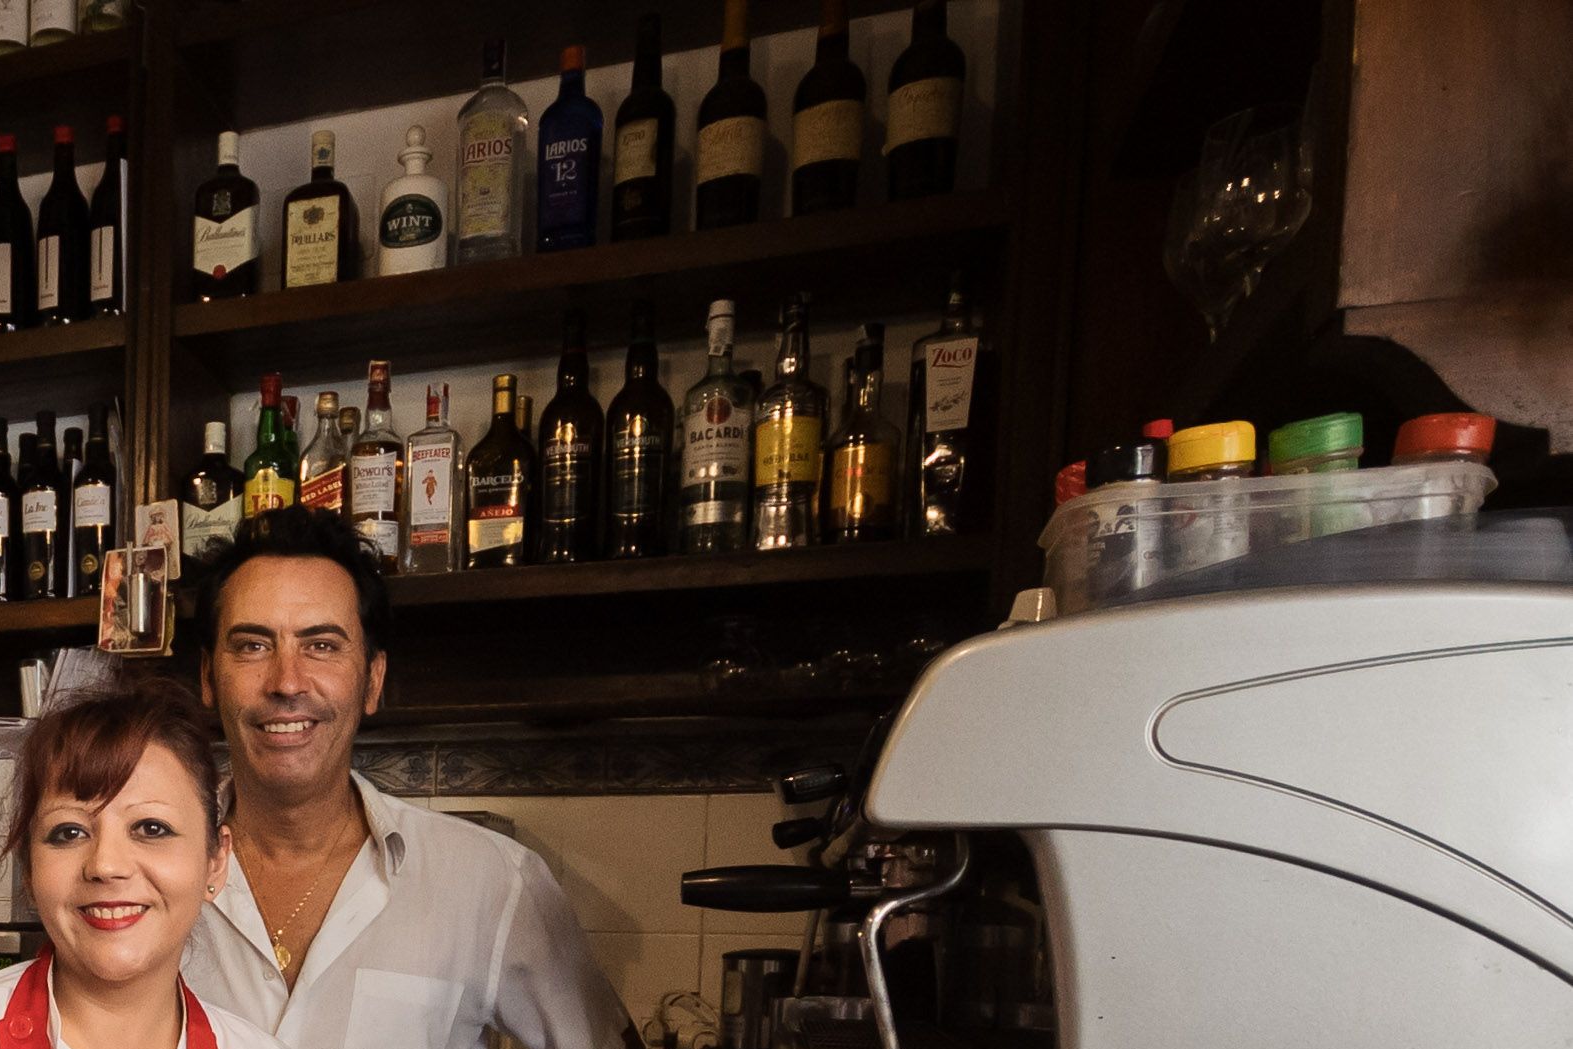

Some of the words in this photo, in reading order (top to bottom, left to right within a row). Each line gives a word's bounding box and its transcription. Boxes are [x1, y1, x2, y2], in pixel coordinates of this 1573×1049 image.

[462, 137, 513, 165] LARIOS
[545, 138, 589, 160] LARIOS
[551, 160, 578, 182] 12
[387, 214, 434, 231] WINT
[412, 447, 451, 463] BEEFEATER
[353, 465, 394, 479] Dewar's
[300, 489, 317, 503] RED
[318, 480, 343, 497] LABEL
[480, 508, 514, 517] AÑEJO
